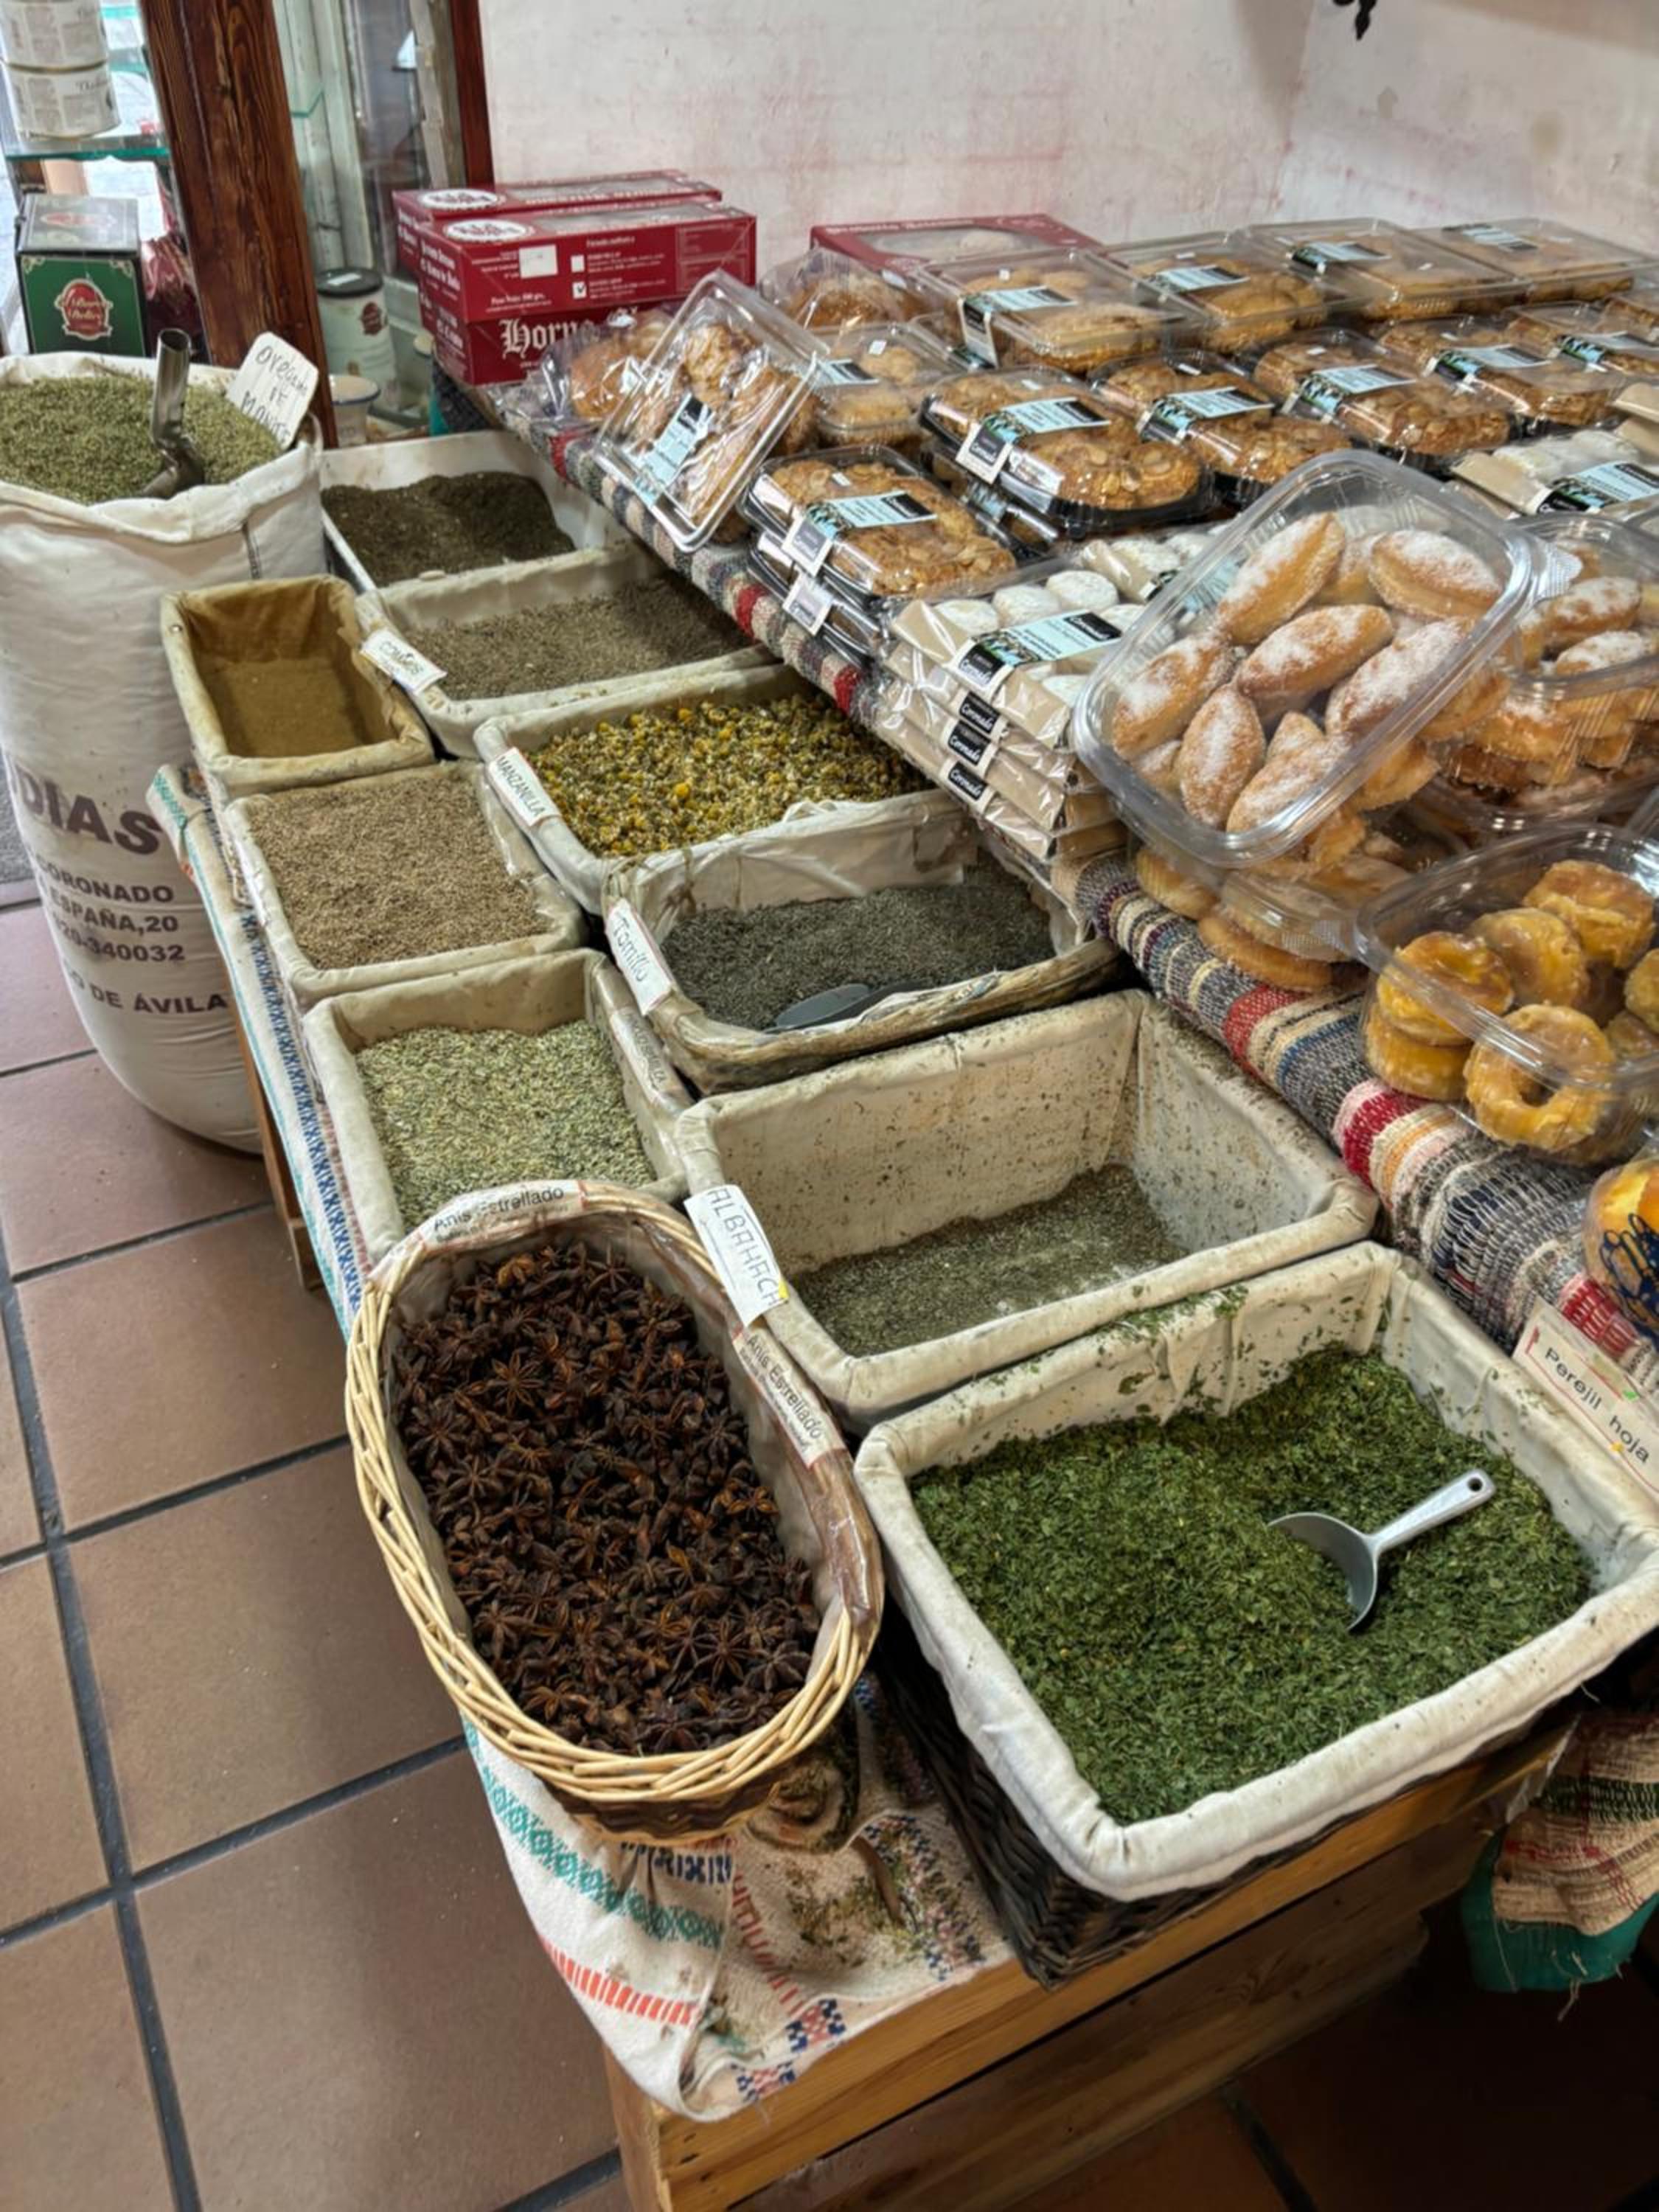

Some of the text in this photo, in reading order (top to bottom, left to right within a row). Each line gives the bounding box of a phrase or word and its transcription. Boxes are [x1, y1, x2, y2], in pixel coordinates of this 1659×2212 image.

[496, 756, 546, 817] MANZANILLA
[90, 983, 122, 1009] DE
[769, 1361, 823, 1441] Estrellado
[1545, 1346, 1650, 1464] Perejil hoja
